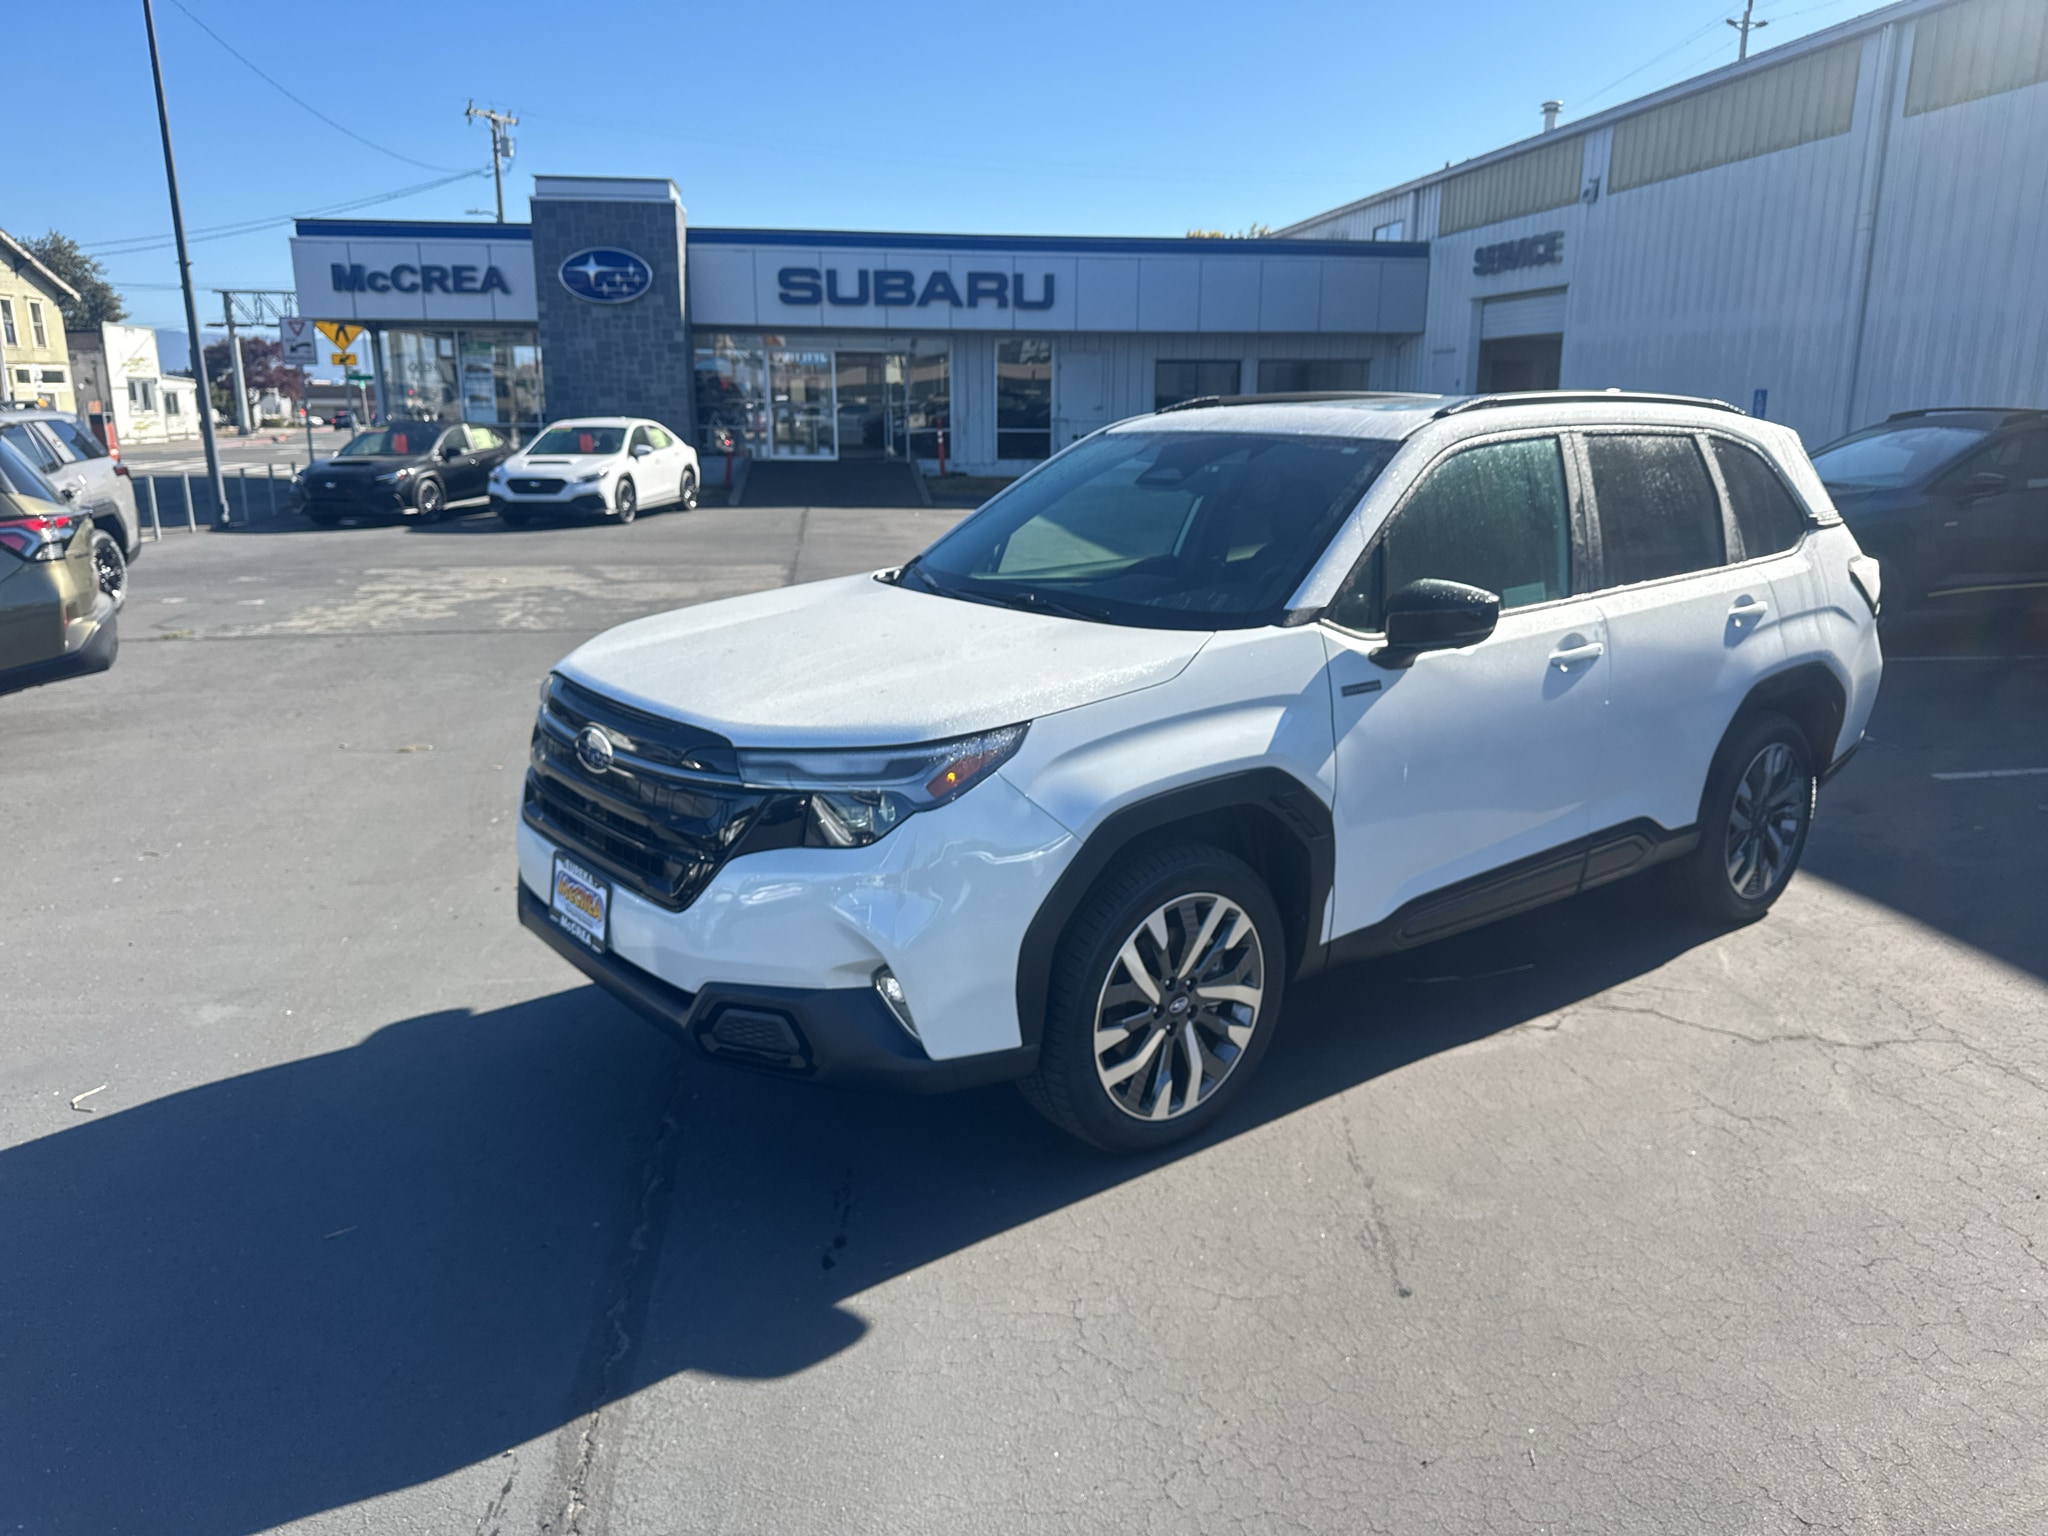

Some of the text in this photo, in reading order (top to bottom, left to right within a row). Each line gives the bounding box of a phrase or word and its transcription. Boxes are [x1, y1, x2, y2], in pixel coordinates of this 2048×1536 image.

[1473, 230, 1564, 276] SERVICE
[331, 263, 511, 295] McCREA
[778, 267, 1056, 310] SUBARU
